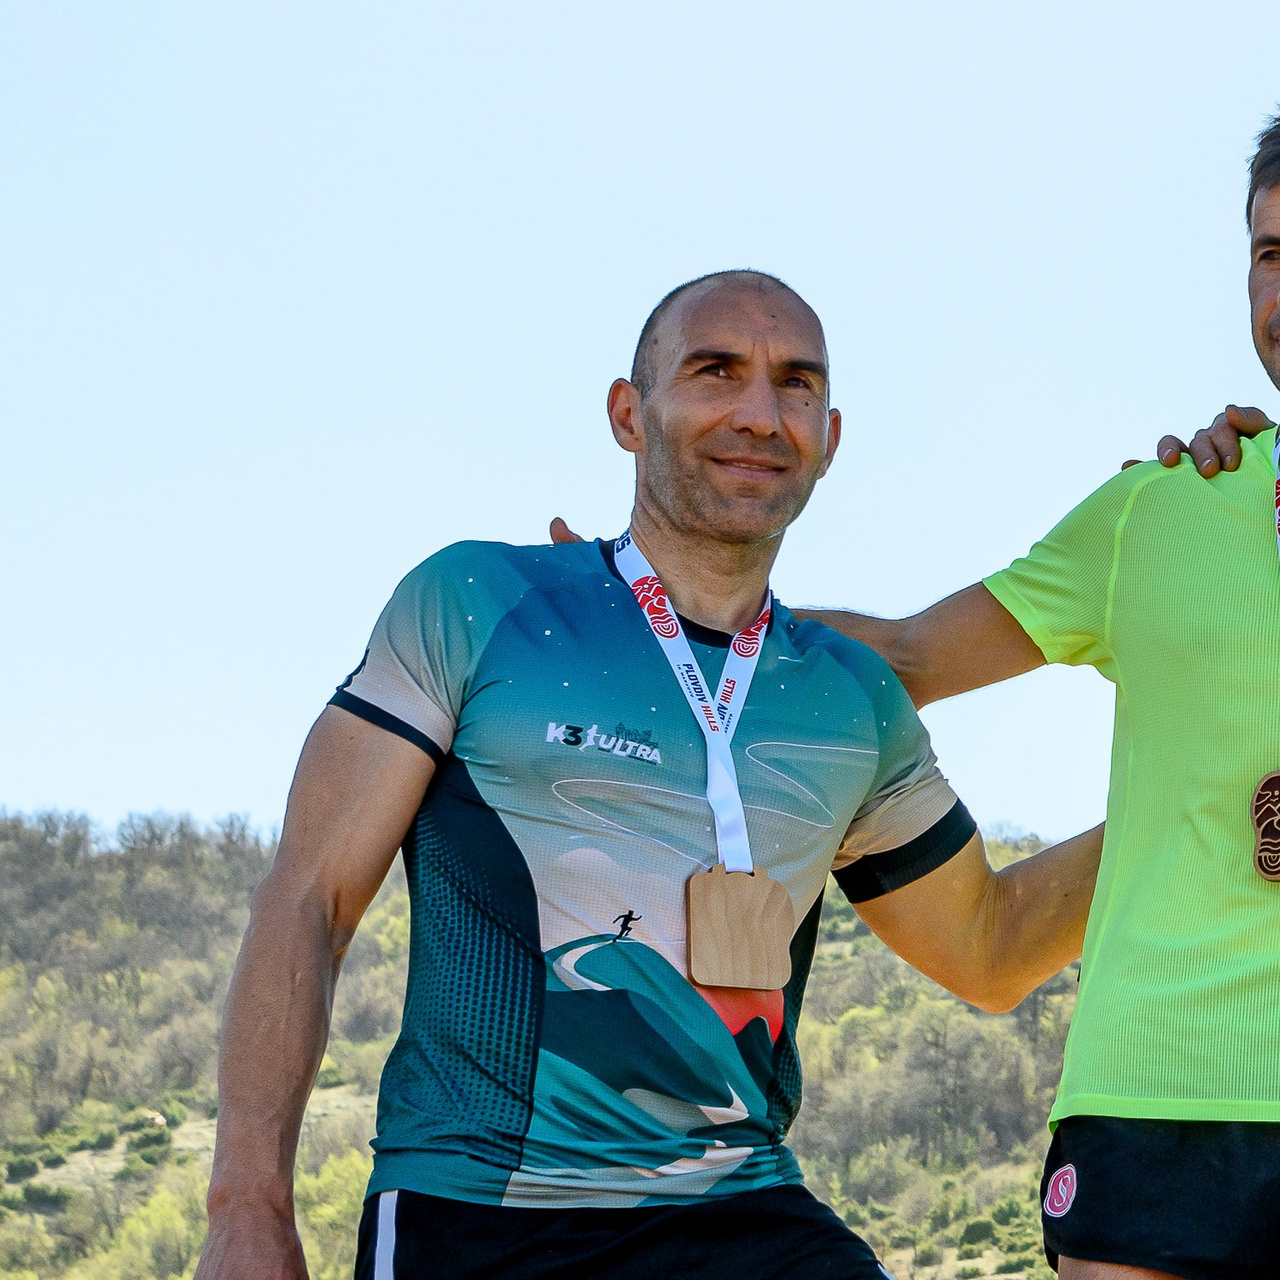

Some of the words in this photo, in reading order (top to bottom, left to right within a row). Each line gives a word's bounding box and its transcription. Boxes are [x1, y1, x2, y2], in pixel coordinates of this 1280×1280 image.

[682, 663, 708, 703] PLOVDIV
[701, 705, 719, 732] HILLS
[720, 677, 736, 704] HILLS
[545, 722, 584, 747] K3
[598, 734, 662, 766] ULTRA
